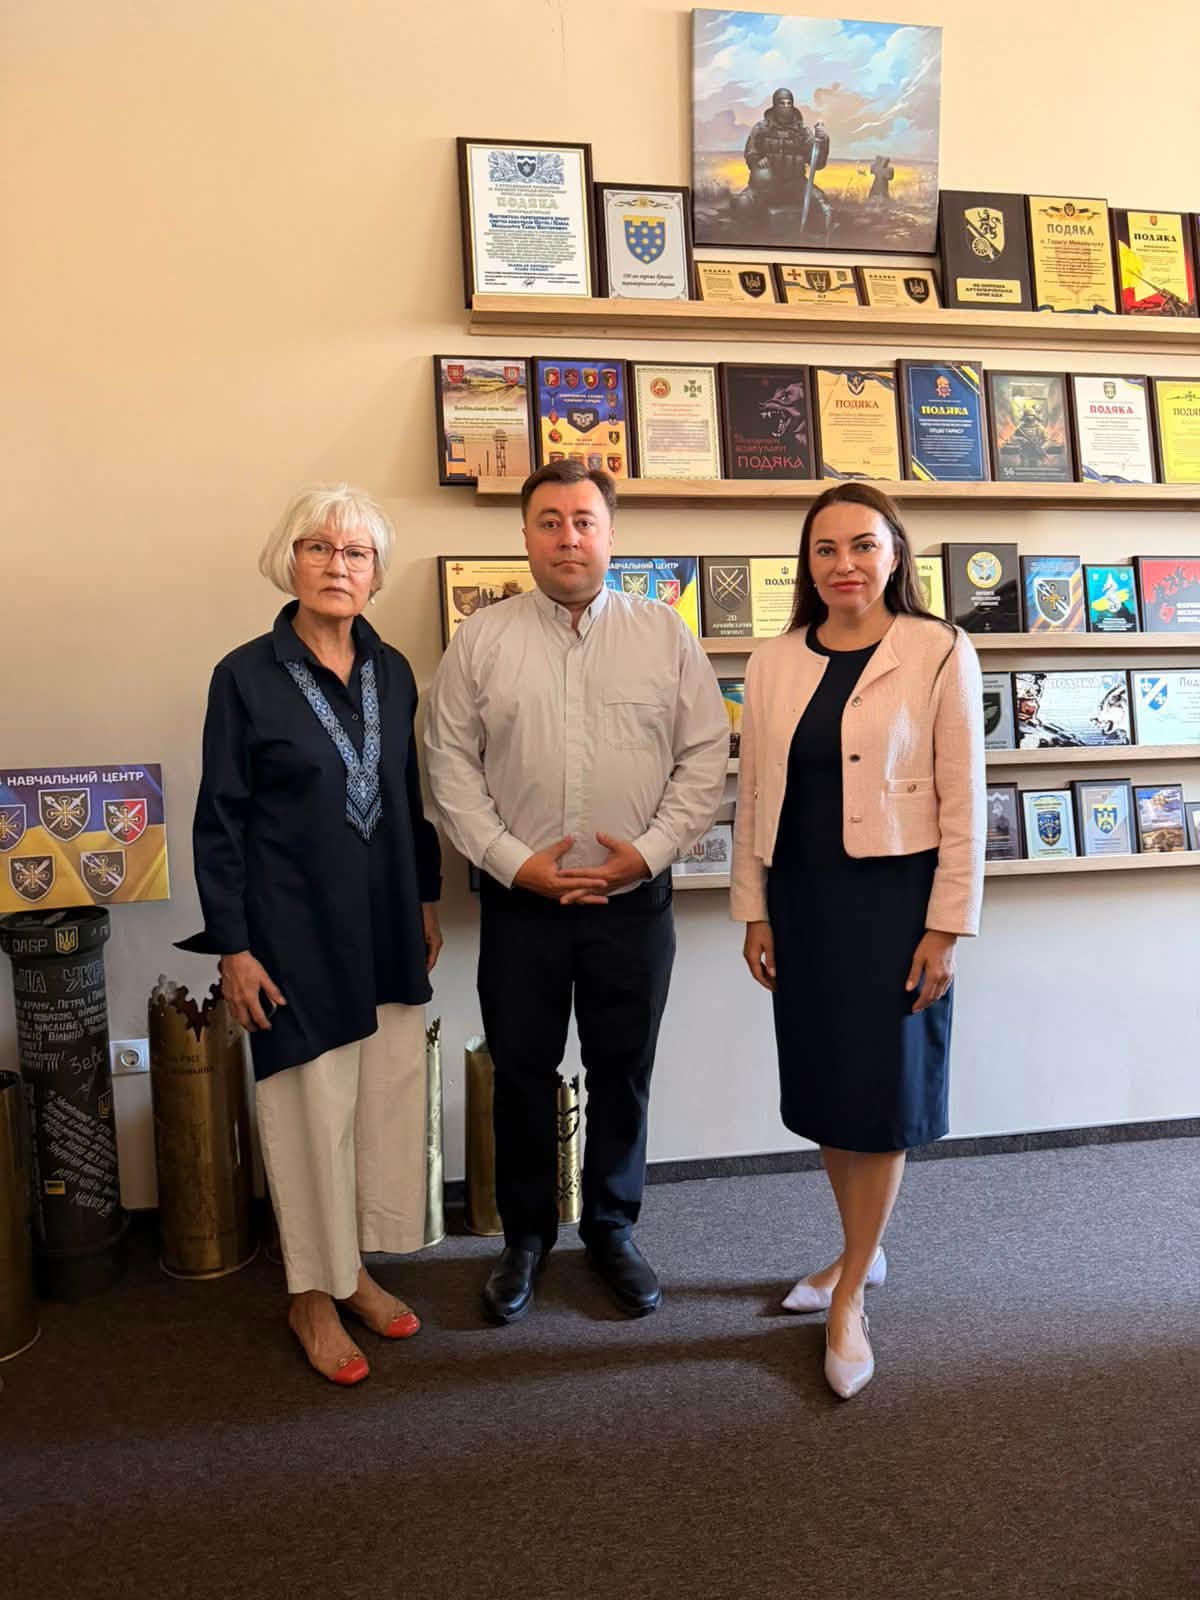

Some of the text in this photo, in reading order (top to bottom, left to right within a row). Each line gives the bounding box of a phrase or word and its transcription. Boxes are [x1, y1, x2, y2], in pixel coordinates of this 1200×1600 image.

[1046, 223, 1094, 236] ПОДЯКА
[1133, 232, 1177, 242] ПОДЯКА
[835, 399, 879, 409] ПОДЯКА
[1090, 404, 1134, 415] ПОДЯКА
[921, 405, 969, 416] ПОДЯКА
[738, 455, 805, 471] ПОДЯКА
[655, 562, 679, 570] ЦЕНТР
[7, 771, 144, 786] НАВЧАЛЬНИЙ ЦЕНТР
